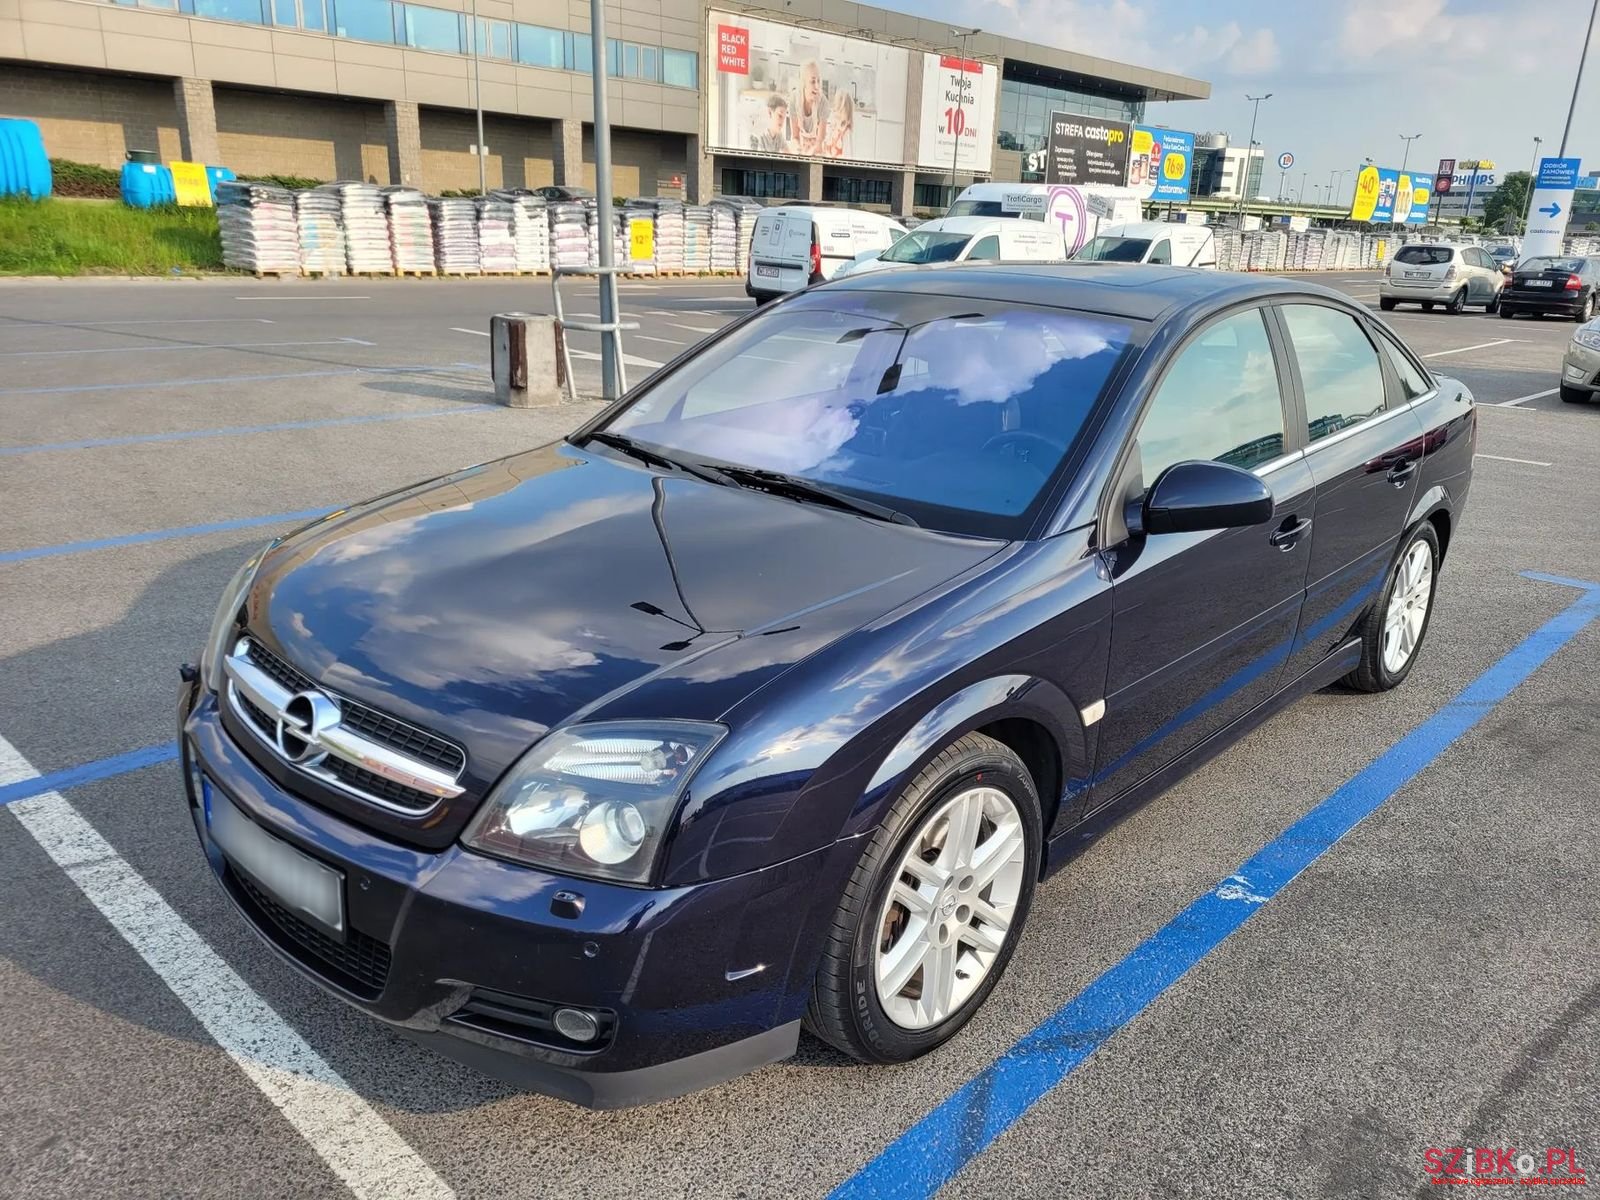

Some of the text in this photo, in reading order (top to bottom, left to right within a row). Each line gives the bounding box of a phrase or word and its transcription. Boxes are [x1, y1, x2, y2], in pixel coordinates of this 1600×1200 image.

[721, 32, 746, 45] BLACK
[721, 44, 737, 55] RED
[721, 55, 745, 68] WHITE
[945, 107, 965, 136] 10
[964, 127, 977, 138] DNI
[1055, 122, 1084, 138] STREFA
[1085, 126, 1124, 146] castopro
